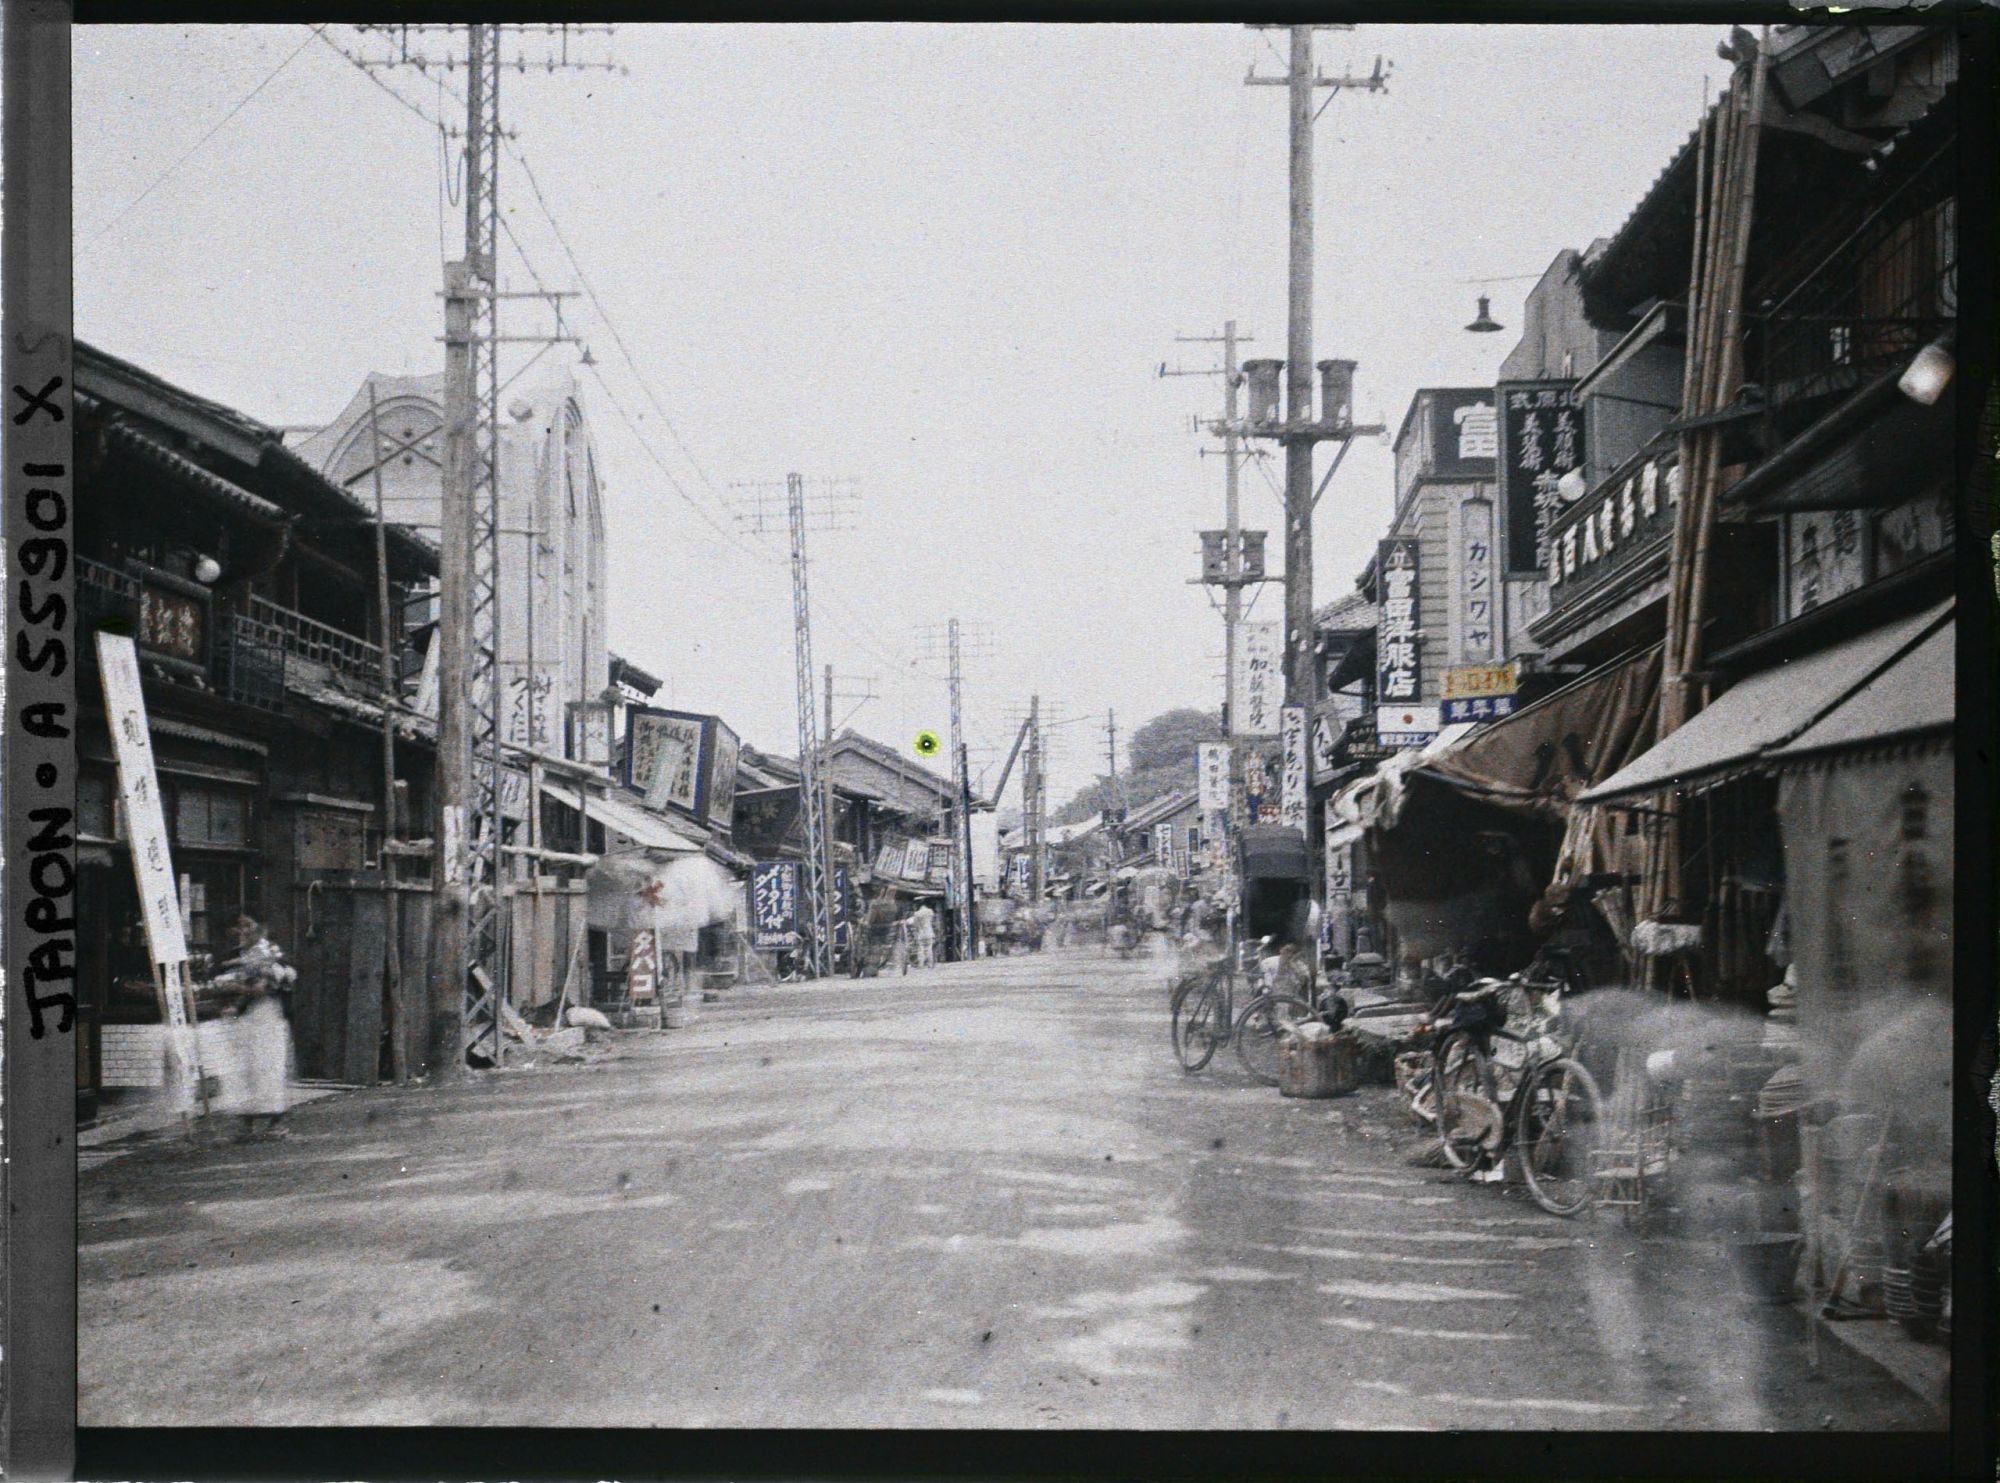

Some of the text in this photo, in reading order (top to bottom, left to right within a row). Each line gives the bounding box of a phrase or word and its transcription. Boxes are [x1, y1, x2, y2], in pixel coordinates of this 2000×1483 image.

[1381, 567, 1417, 698] 富田洋服店
[1468, 541, 1488, 647] カシワヤ
[755, 873, 769, 927] タクシー
